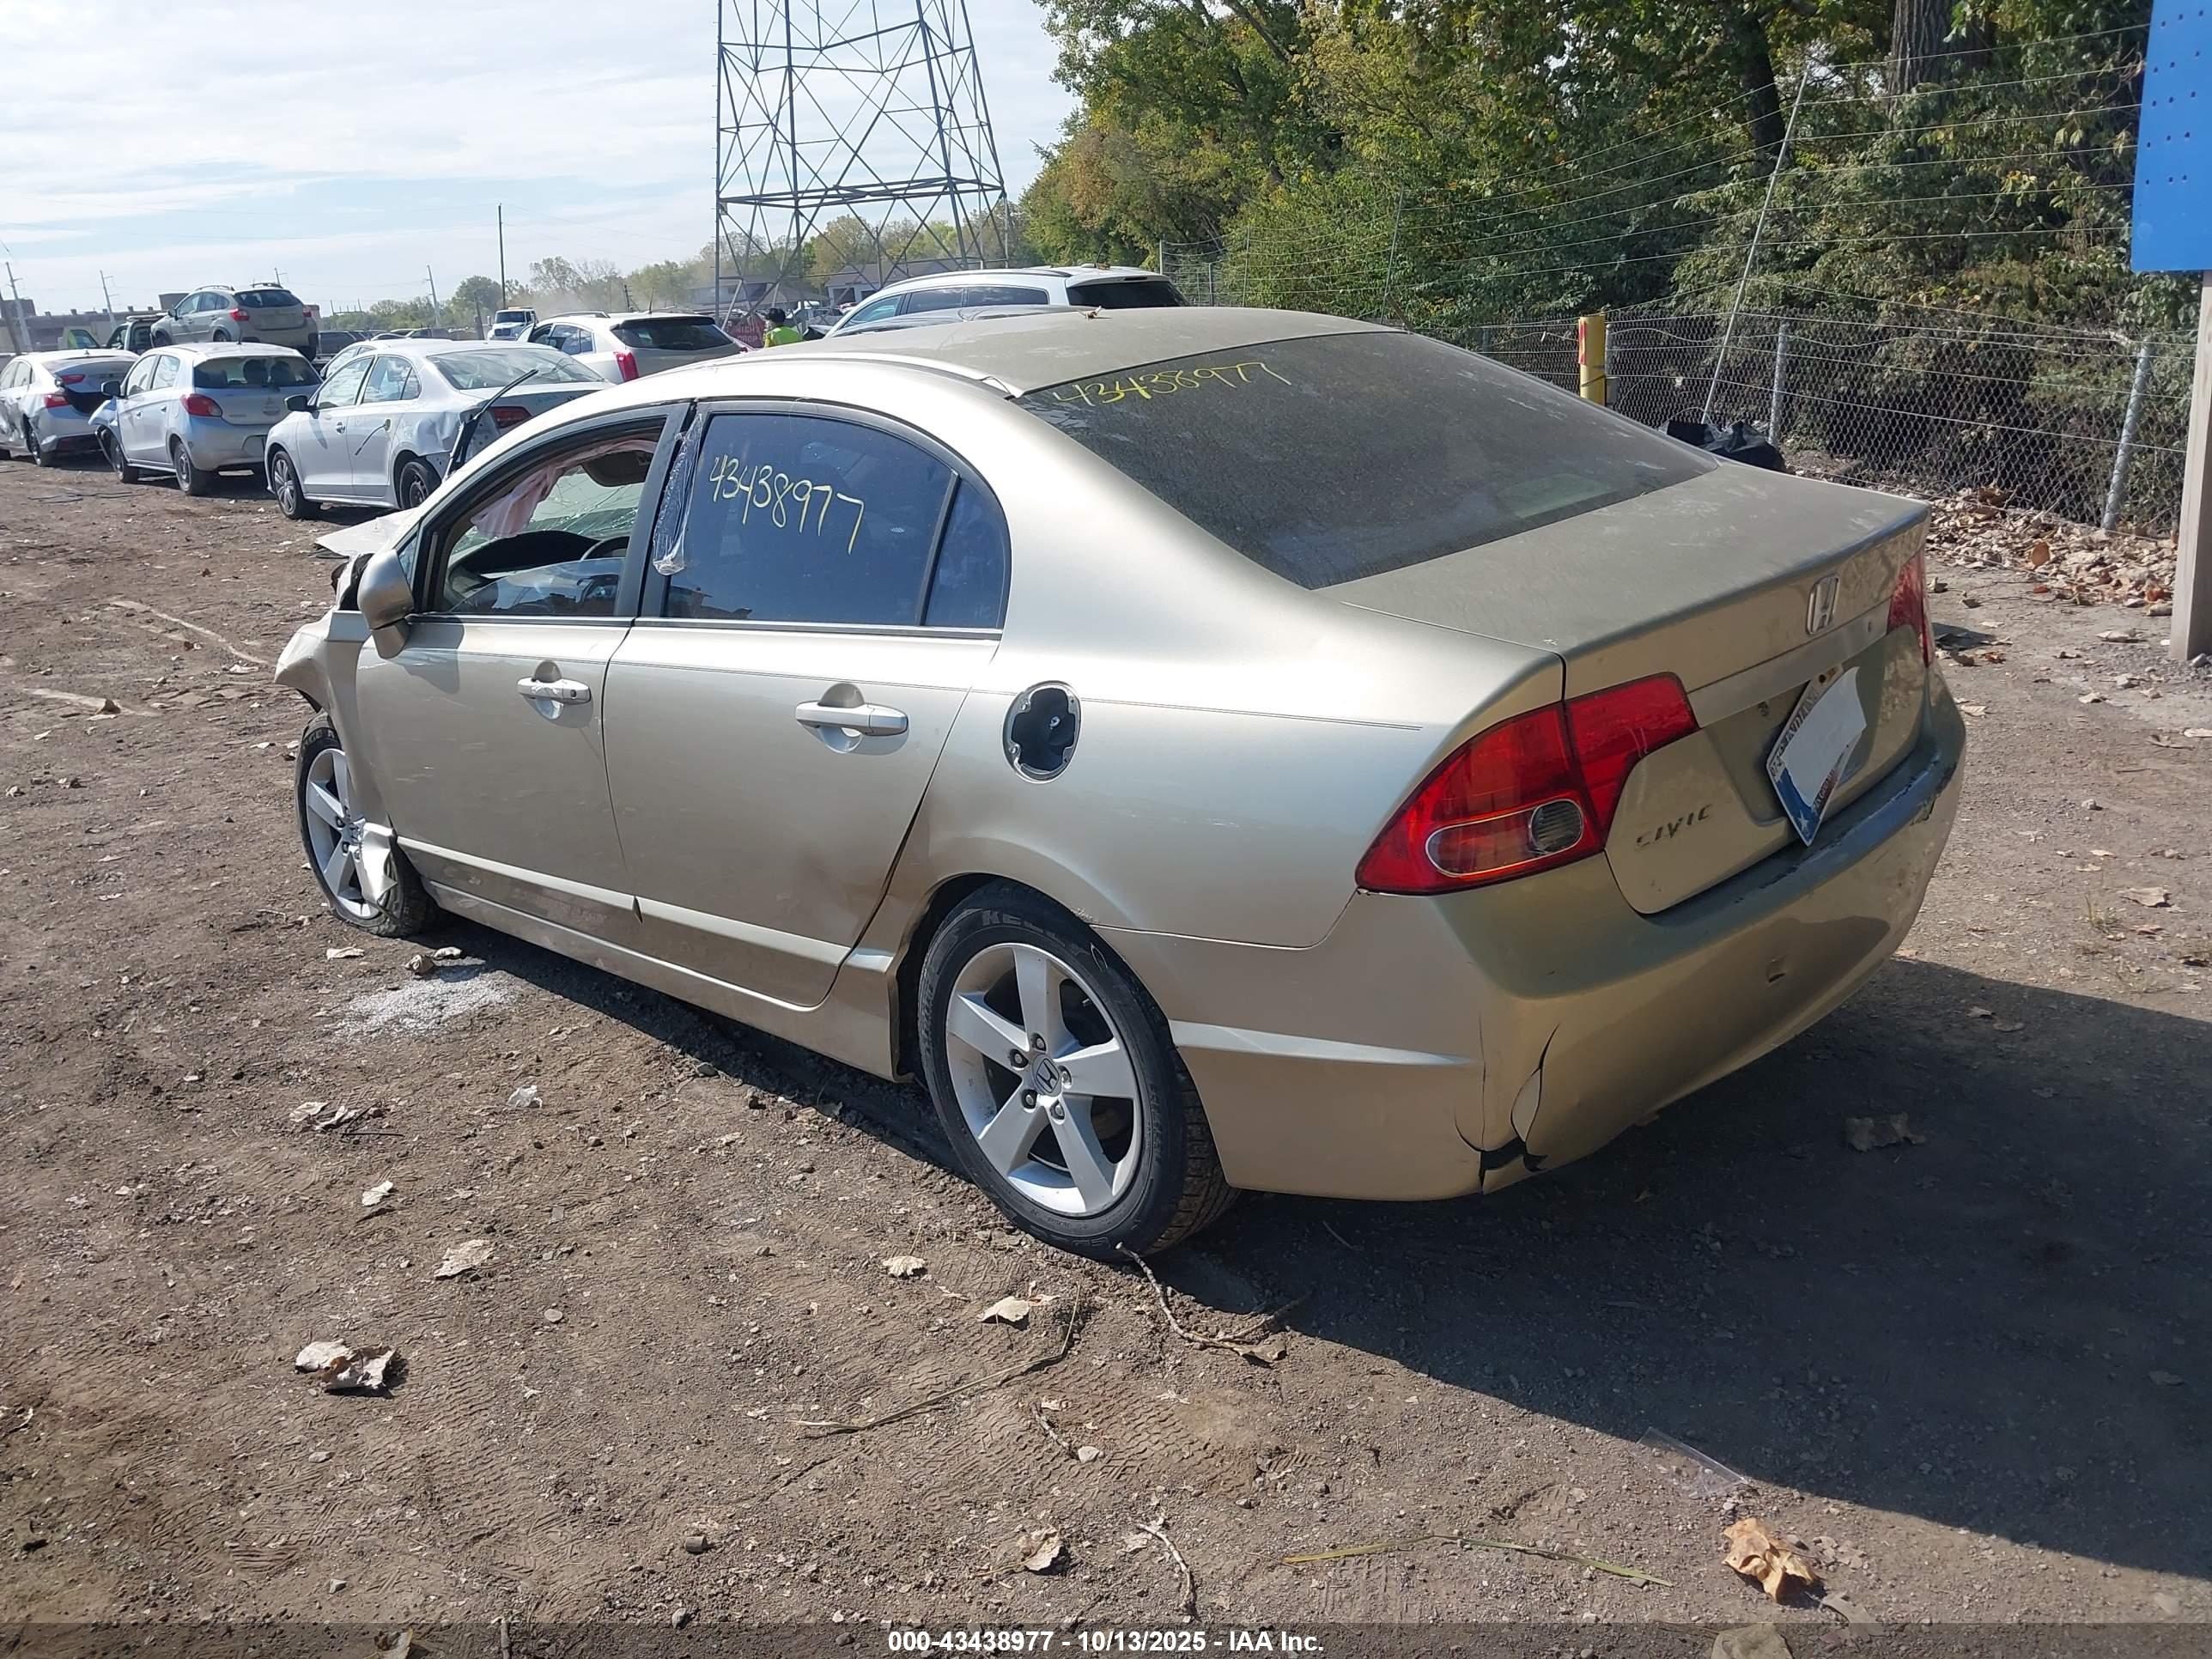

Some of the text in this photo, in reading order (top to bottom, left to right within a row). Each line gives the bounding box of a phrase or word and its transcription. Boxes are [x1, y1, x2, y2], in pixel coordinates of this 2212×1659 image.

[1053, 362, 1291, 406] 43438977
[709, 453, 865, 556] 43438977
[1636, 803, 1713, 848] CIVIC
